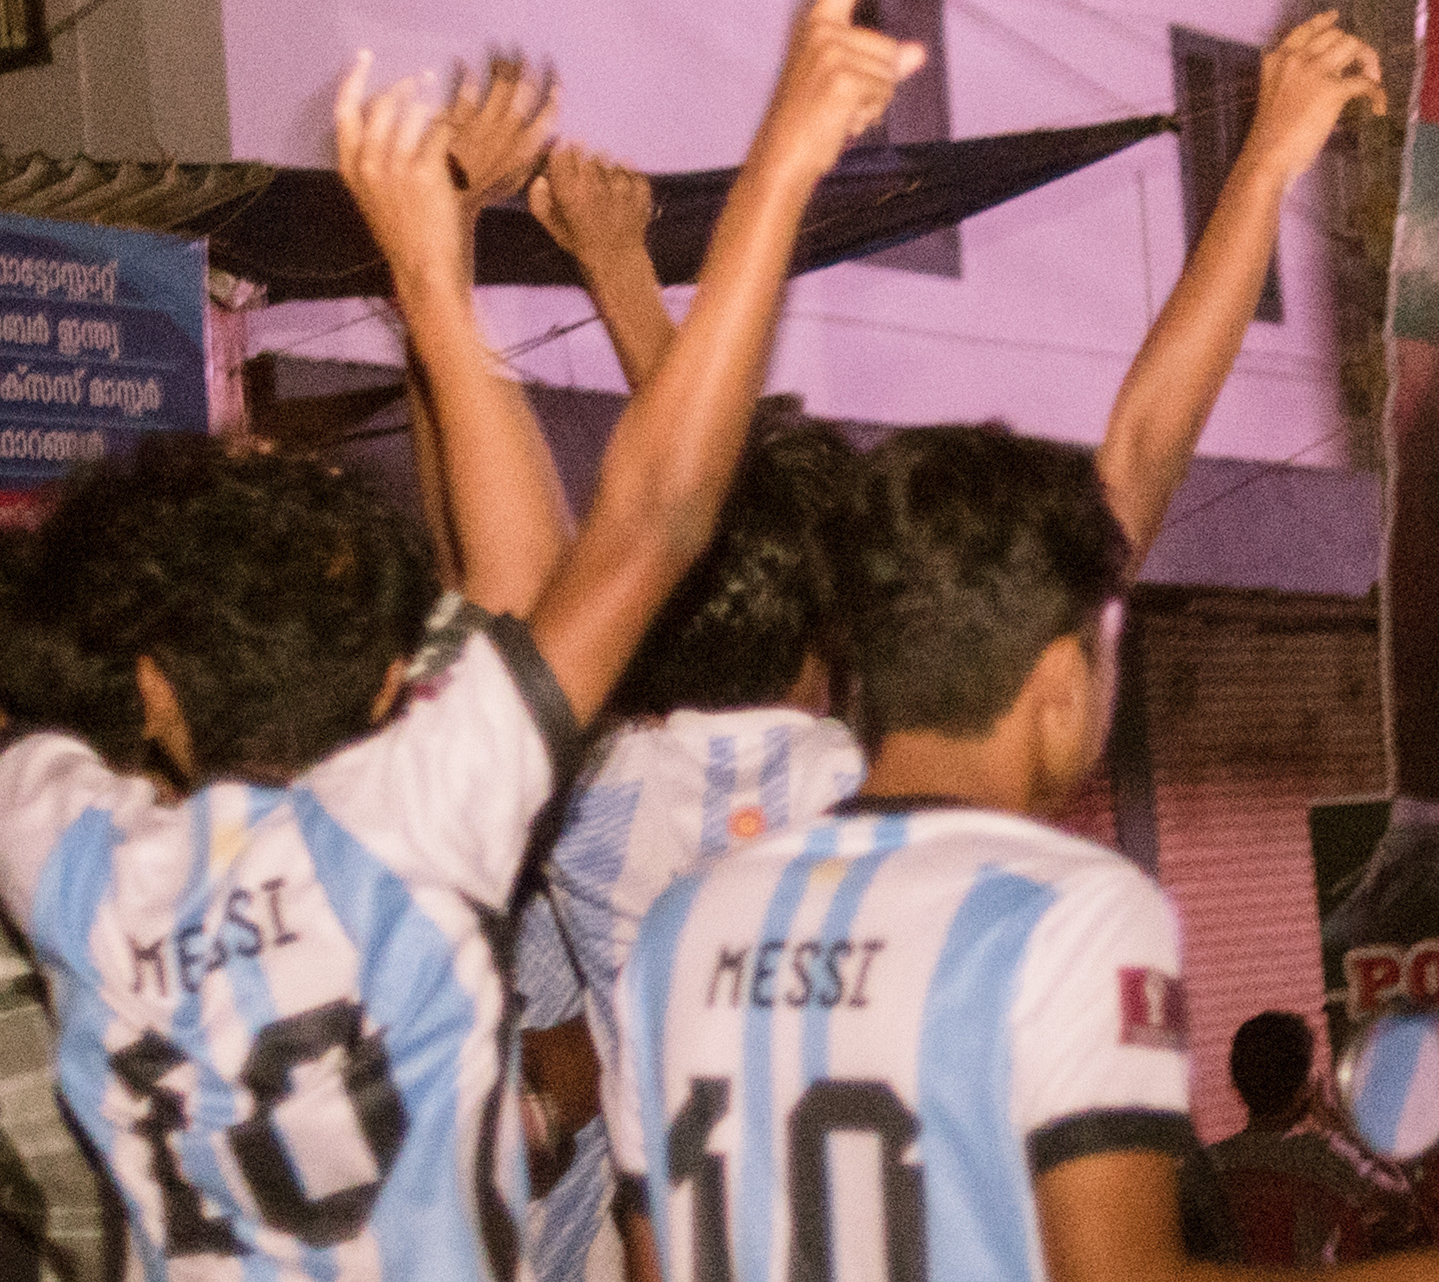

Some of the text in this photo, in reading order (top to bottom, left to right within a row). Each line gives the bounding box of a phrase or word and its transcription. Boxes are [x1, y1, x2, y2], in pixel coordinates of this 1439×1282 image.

[130, 876, 300, 1001] MESSI
[706, 938, 886, 1012] MESSI
[111, 997, 410, 1257] 10
